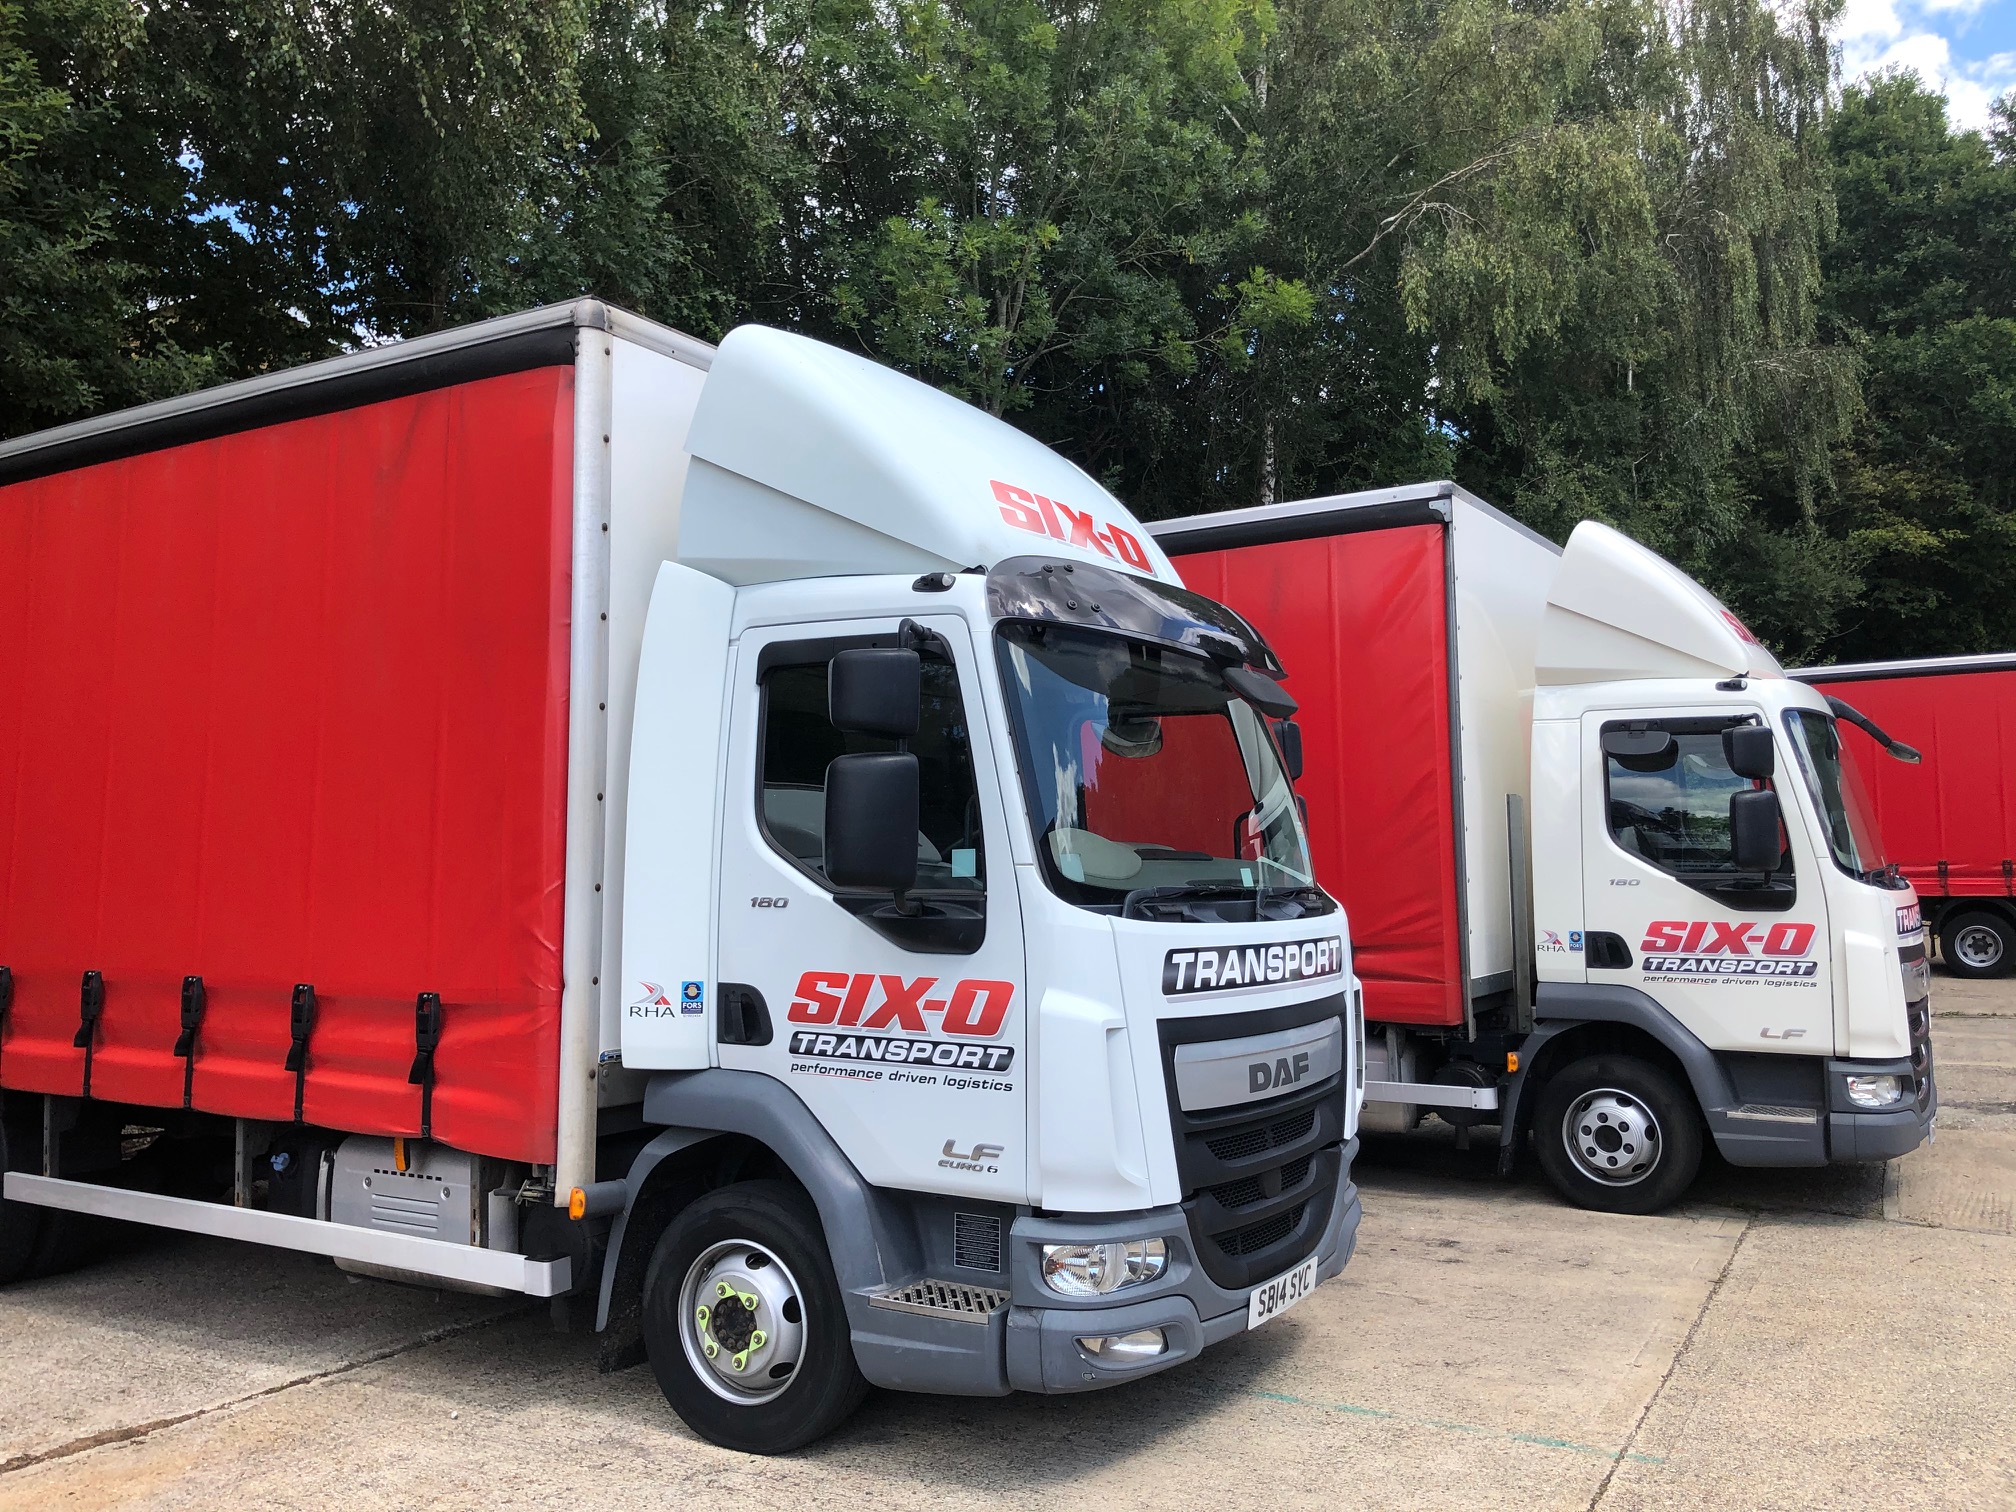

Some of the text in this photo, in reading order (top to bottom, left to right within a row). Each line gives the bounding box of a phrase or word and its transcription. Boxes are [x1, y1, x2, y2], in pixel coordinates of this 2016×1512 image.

[989, 479, 1156, 575] SIX-O
[1609, 878, 1641, 886] 180
[750, 896, 790, 909] 180
[1536, 944, 1567, 953] RHA
[1640, 920, 1816, 957] SIX-O
[1171, 938, 1341, 991] TRANSPORT
[1648, 958, 1813, 975] TRANSPORT
[1642, 974, 1818, 988] performance driven logistics
[629, 1006, 676, 1018] RHA
[786, 970, 1016, 1037] SIX-O
[1760, 1027, 1808, 1040] LF
[797, 1033, 1009, 1069] TRANSPORT
[790, 1063, 1014, 1092] performance driven logistics
[1248, 1052, 1309, 1094] DAF
[942, 1138, 1005, 1161] LF
[937, 1159, 999, 1174] EURO 6
[1258, 1264, 1312, 1318] SB14 SYC
